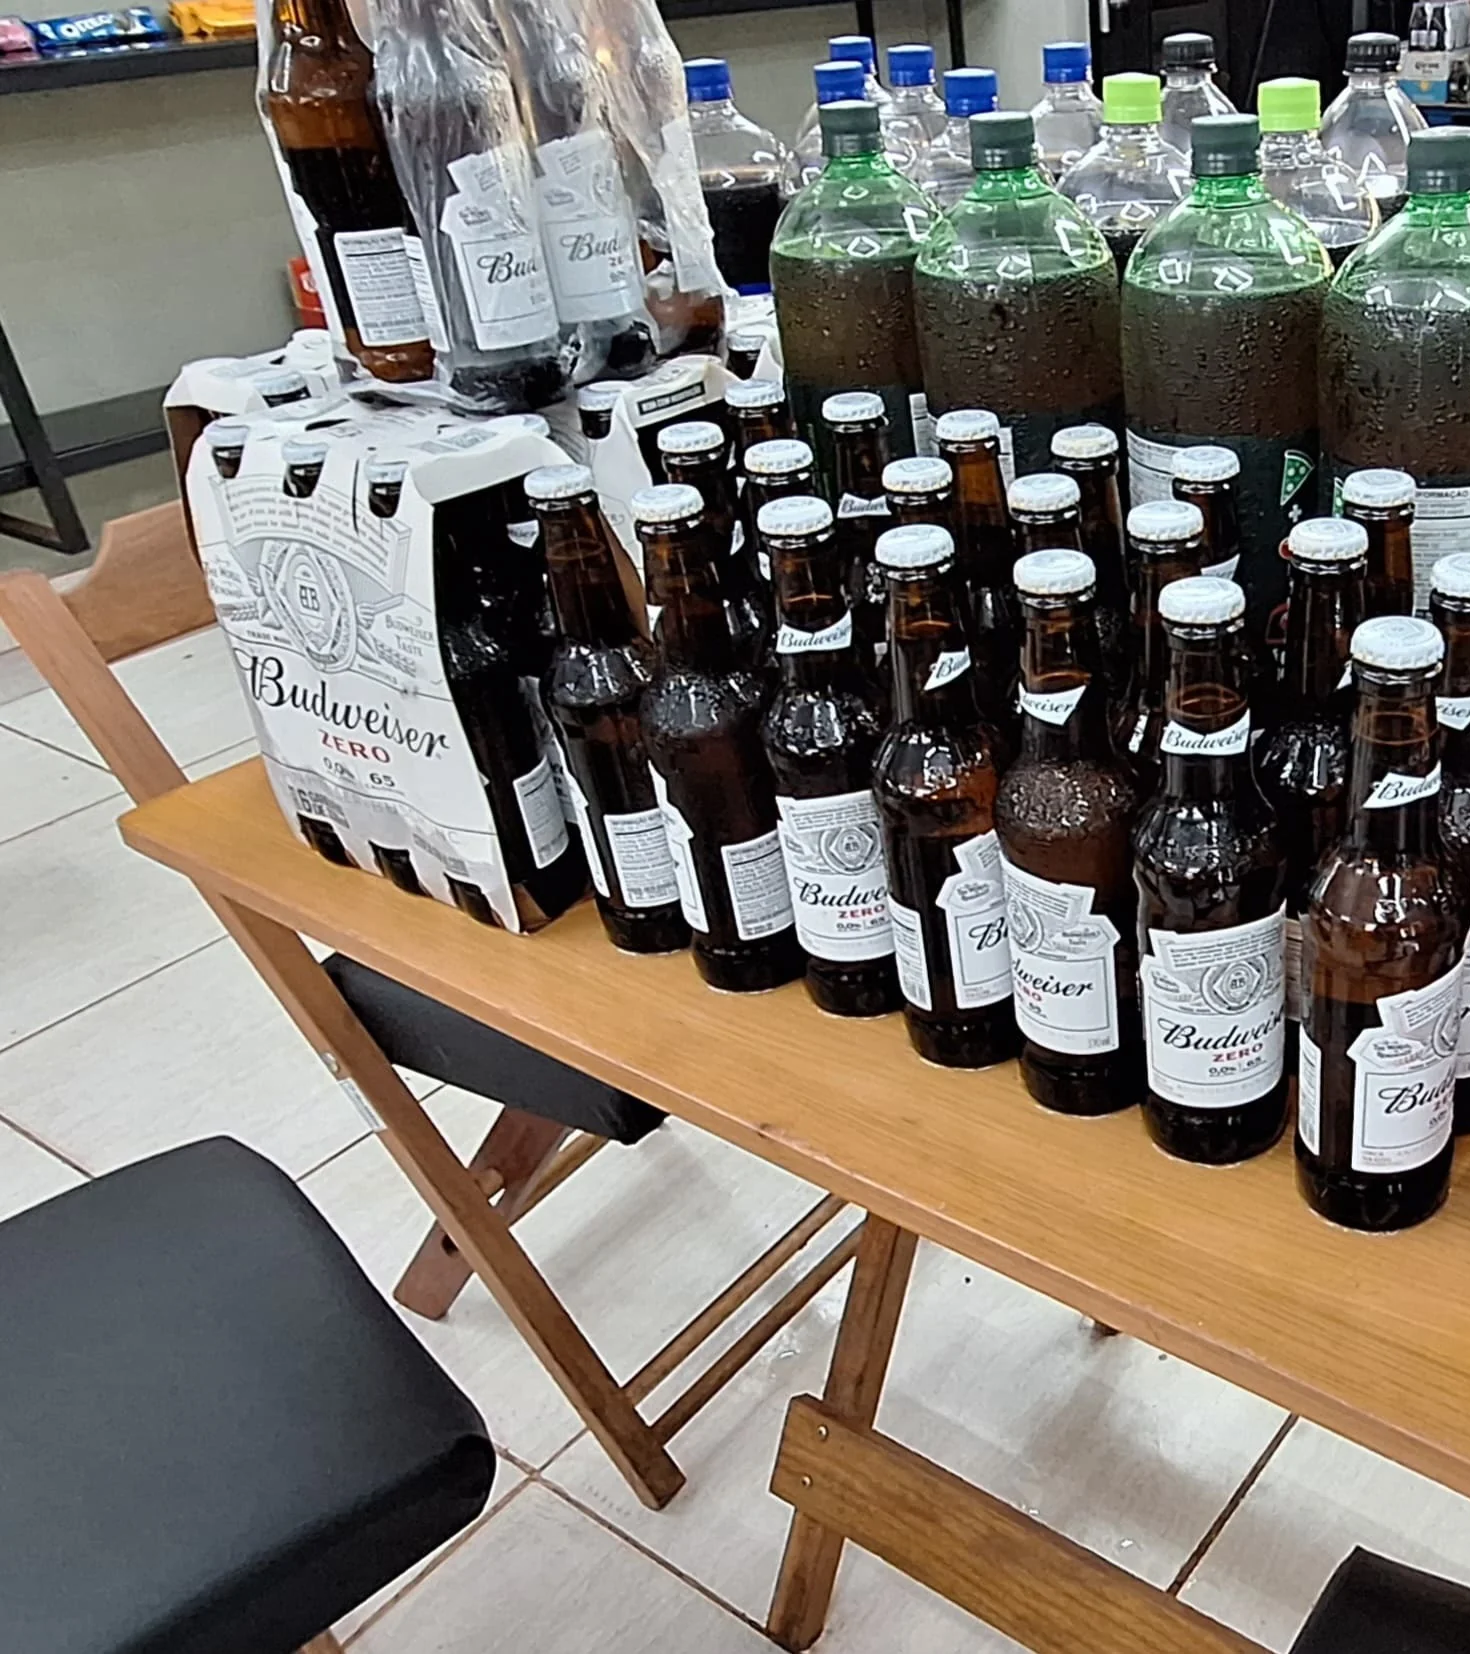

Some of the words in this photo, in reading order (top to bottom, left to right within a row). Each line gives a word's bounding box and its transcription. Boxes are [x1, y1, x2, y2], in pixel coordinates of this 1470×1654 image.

[231, 647, 451, 758] Budweiser
[318, 728, 391, 764] ZERO
[838, 903, 886, 919] ZERO
[1211, 1043, 1264, 1063] ZERO
